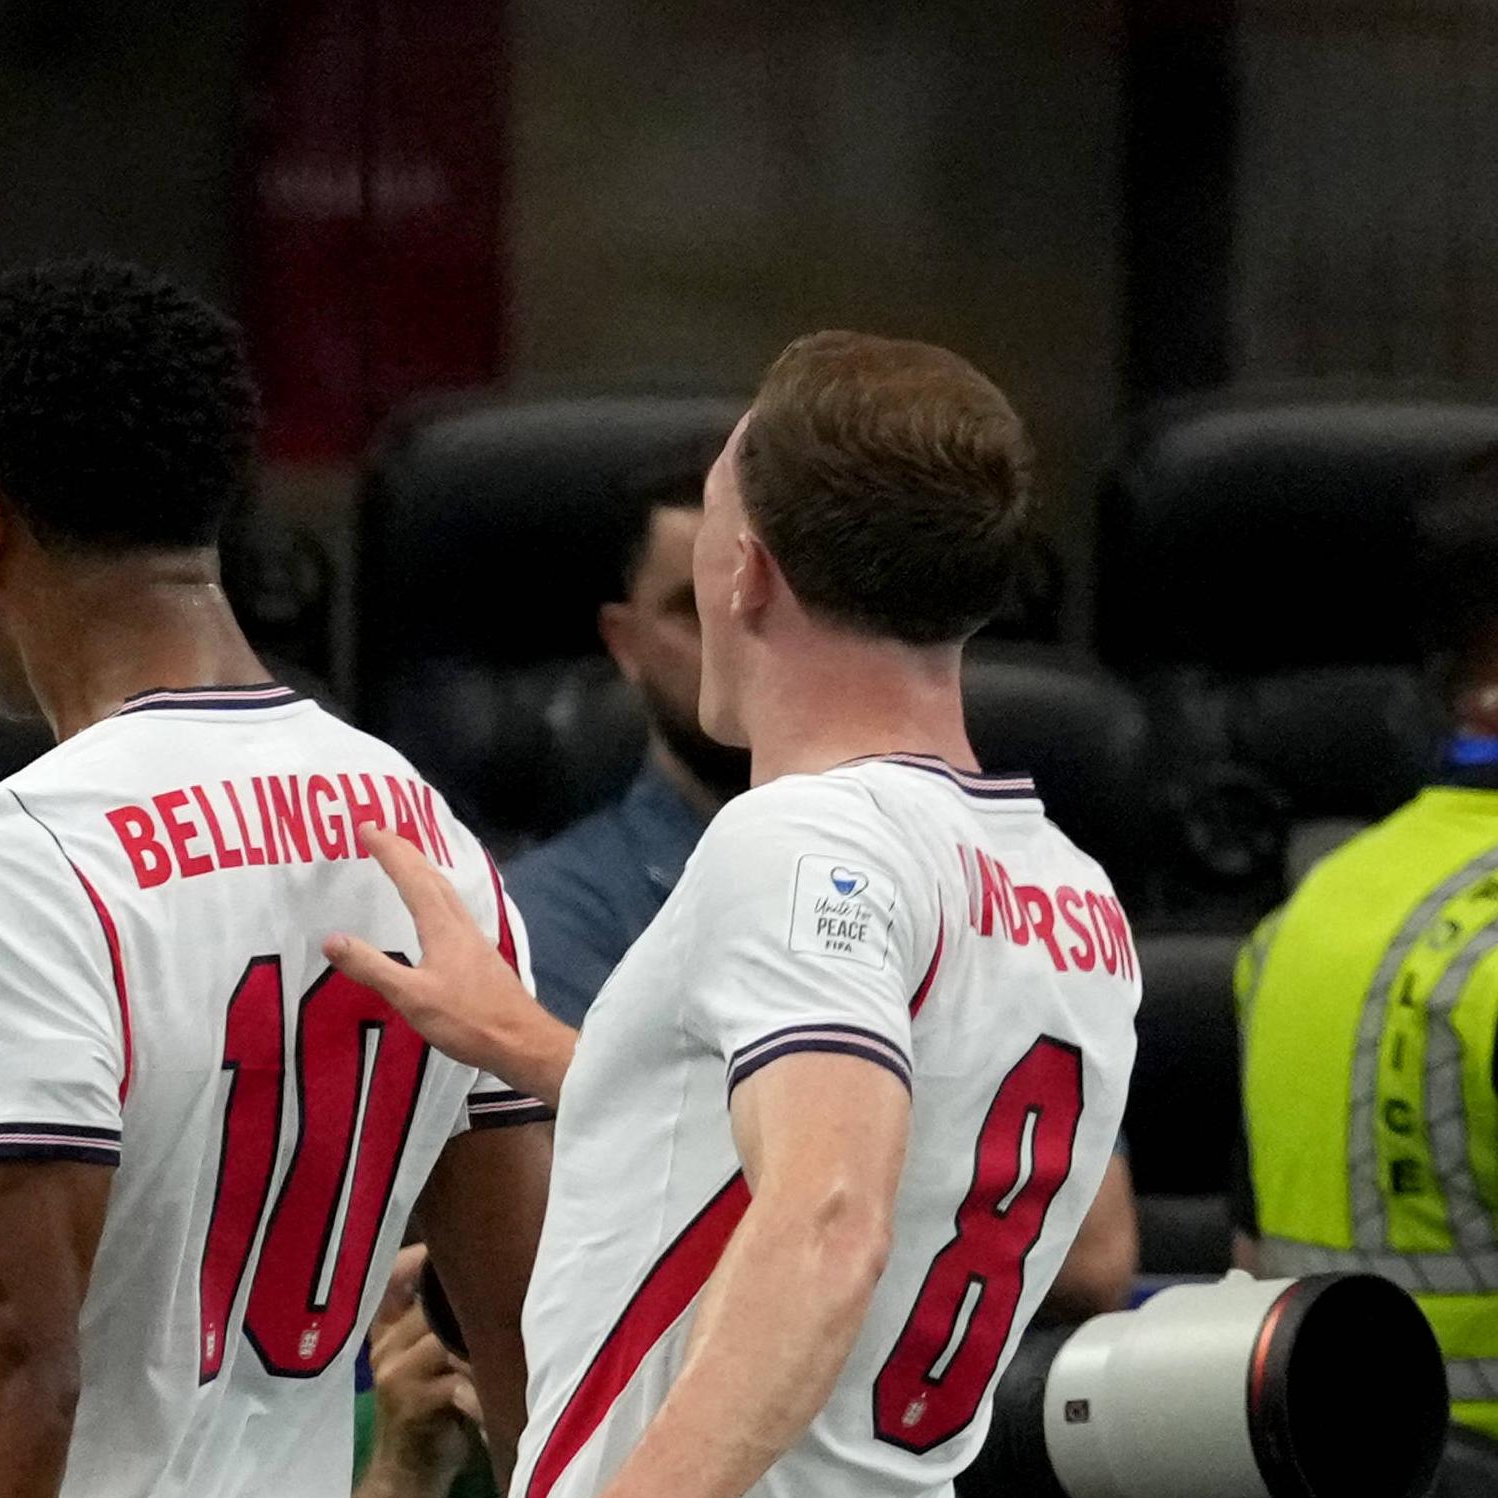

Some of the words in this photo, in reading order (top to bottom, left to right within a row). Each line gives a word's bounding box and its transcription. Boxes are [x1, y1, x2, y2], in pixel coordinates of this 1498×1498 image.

[816, 917, 868, 943] PEACE
[825, 940, 853, 953] FIFA
[198, 951, 430, 1386] 10
[872, 1033, 1084, 1454] 8
